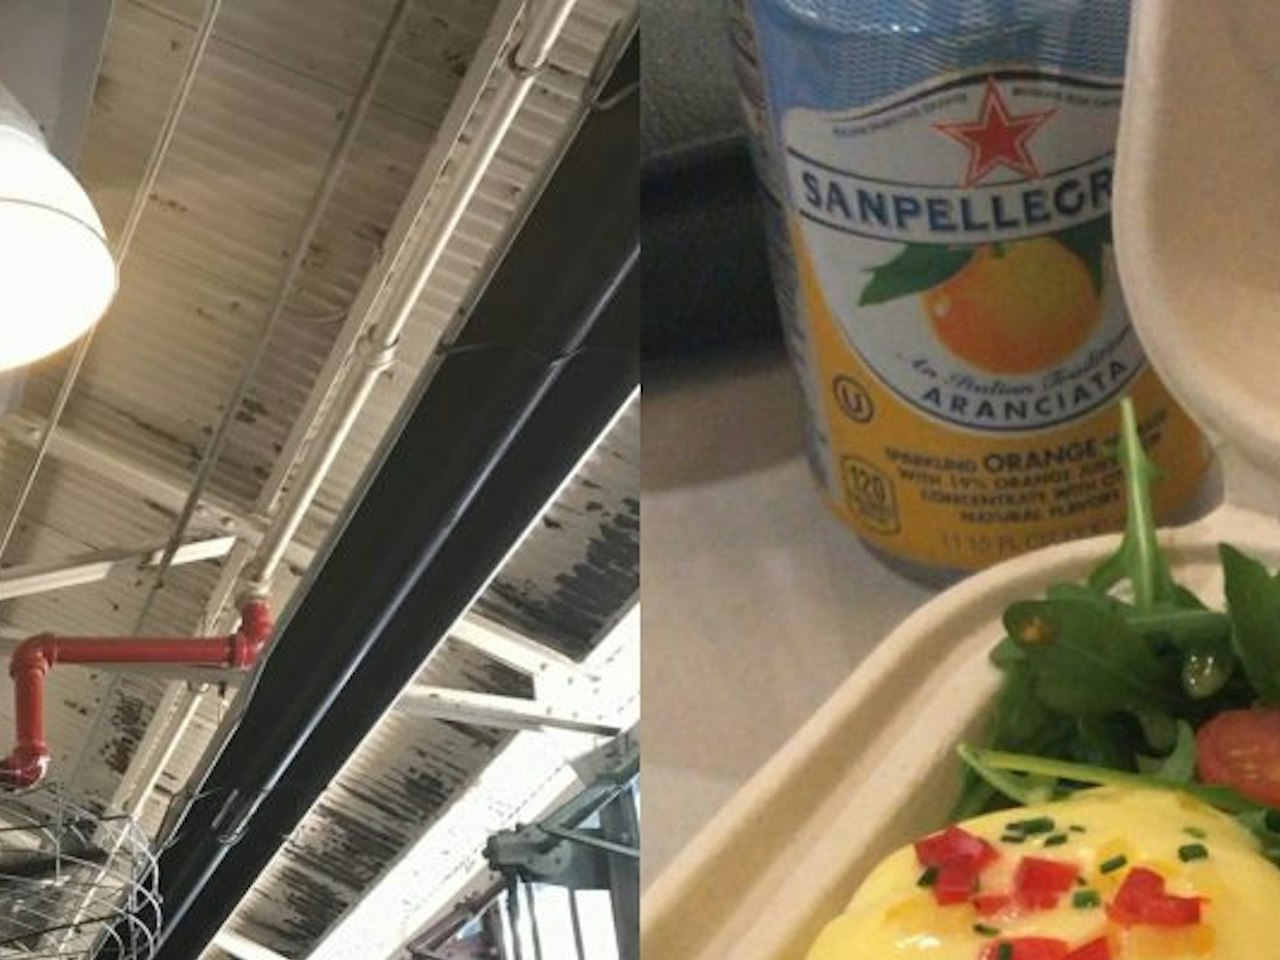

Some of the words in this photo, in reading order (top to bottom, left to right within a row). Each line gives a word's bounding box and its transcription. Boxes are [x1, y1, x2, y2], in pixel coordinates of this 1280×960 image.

[922, 360, 1128, 420] ARANCIATA
[983, 438, 1098, 473] ORANGE
[850, 464, 887, 501] 120
